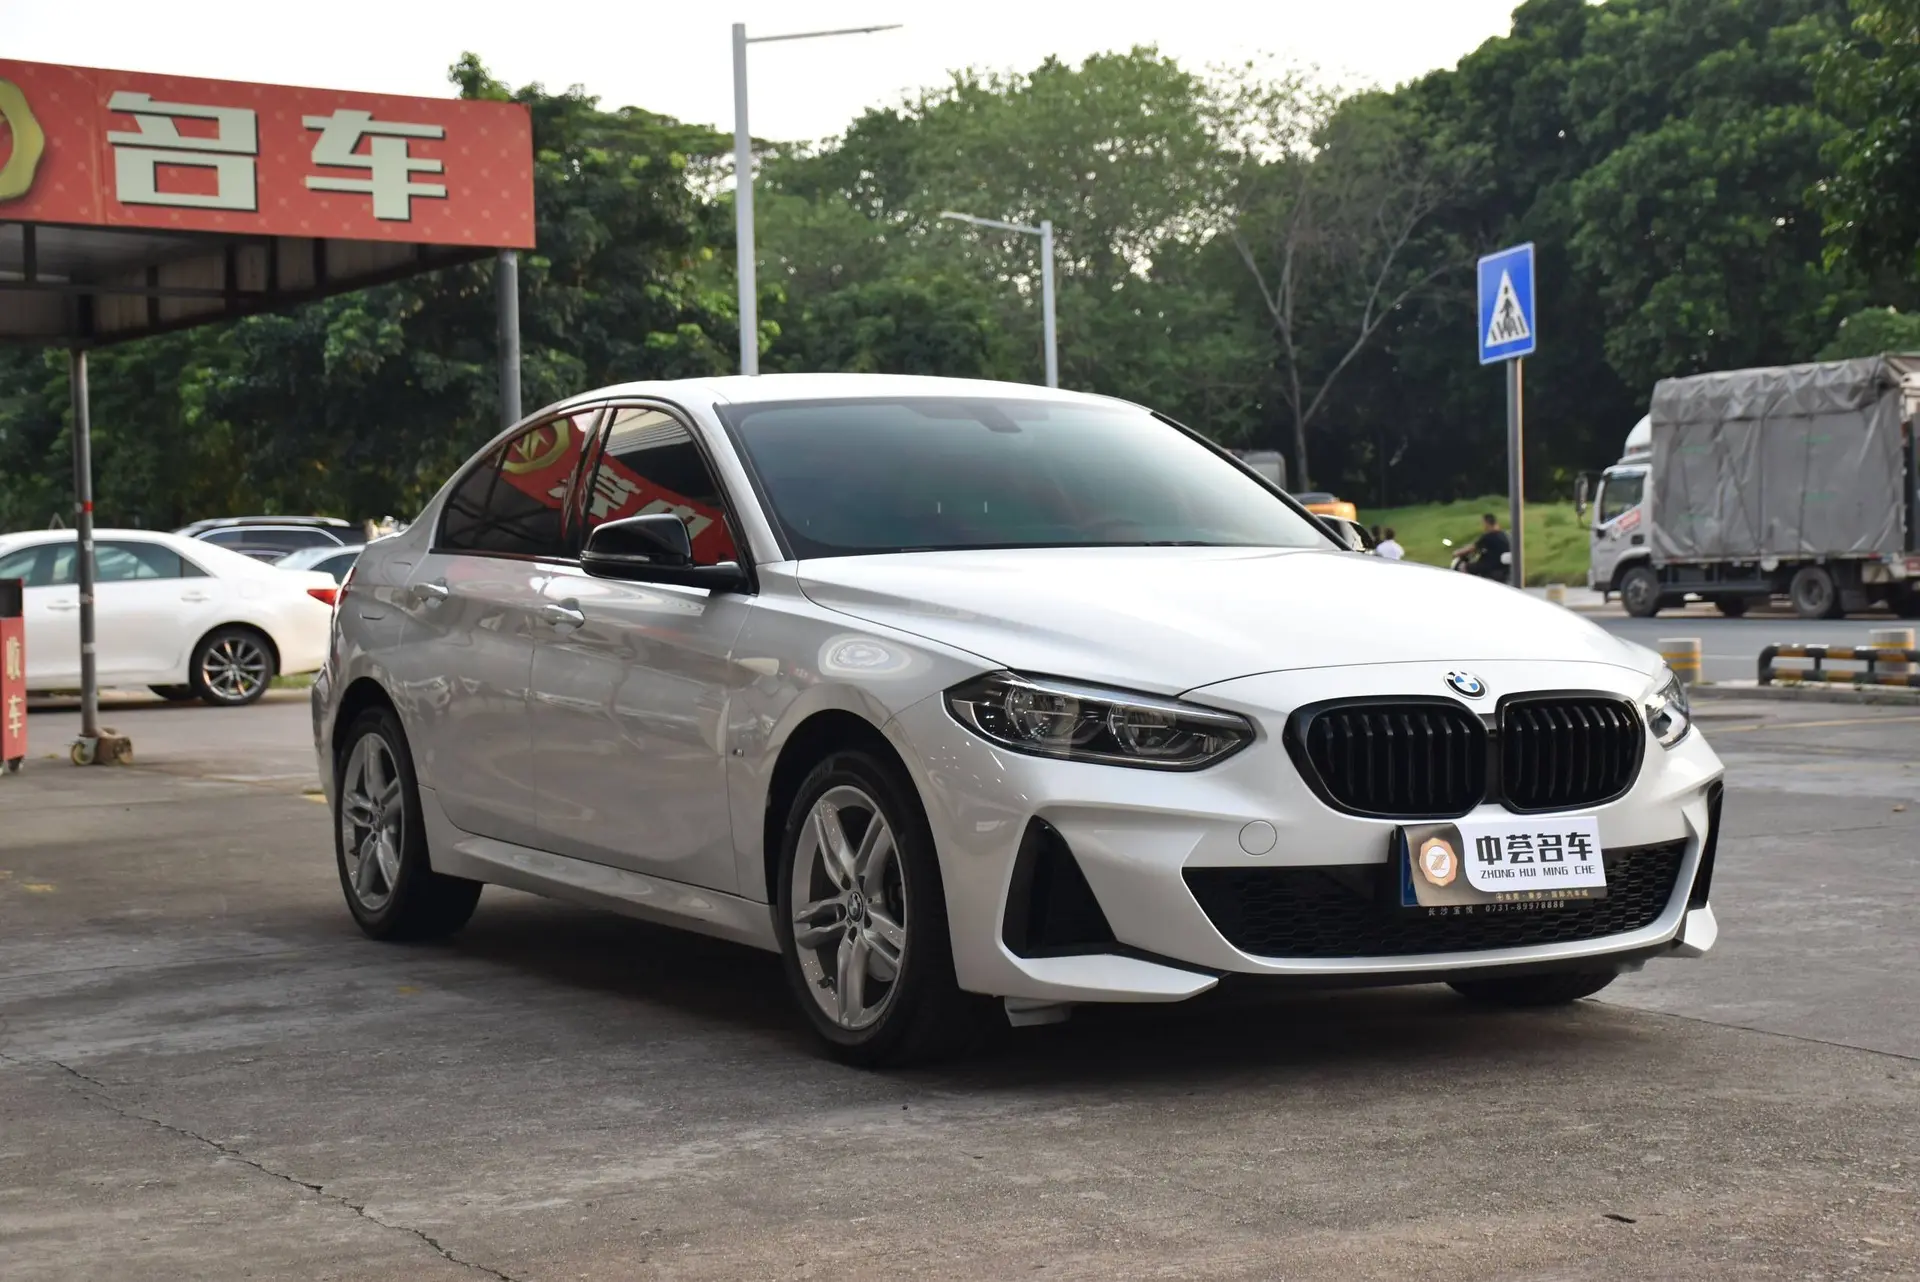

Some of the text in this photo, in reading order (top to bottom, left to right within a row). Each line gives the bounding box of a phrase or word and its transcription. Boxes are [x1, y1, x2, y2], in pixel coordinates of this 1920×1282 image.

[107, 90, 447, 221] 名车
[1475, 831, 1594, 866] 中荟名车
[1480, 864, 1596, 880] ZHONG HUI MING CHE
